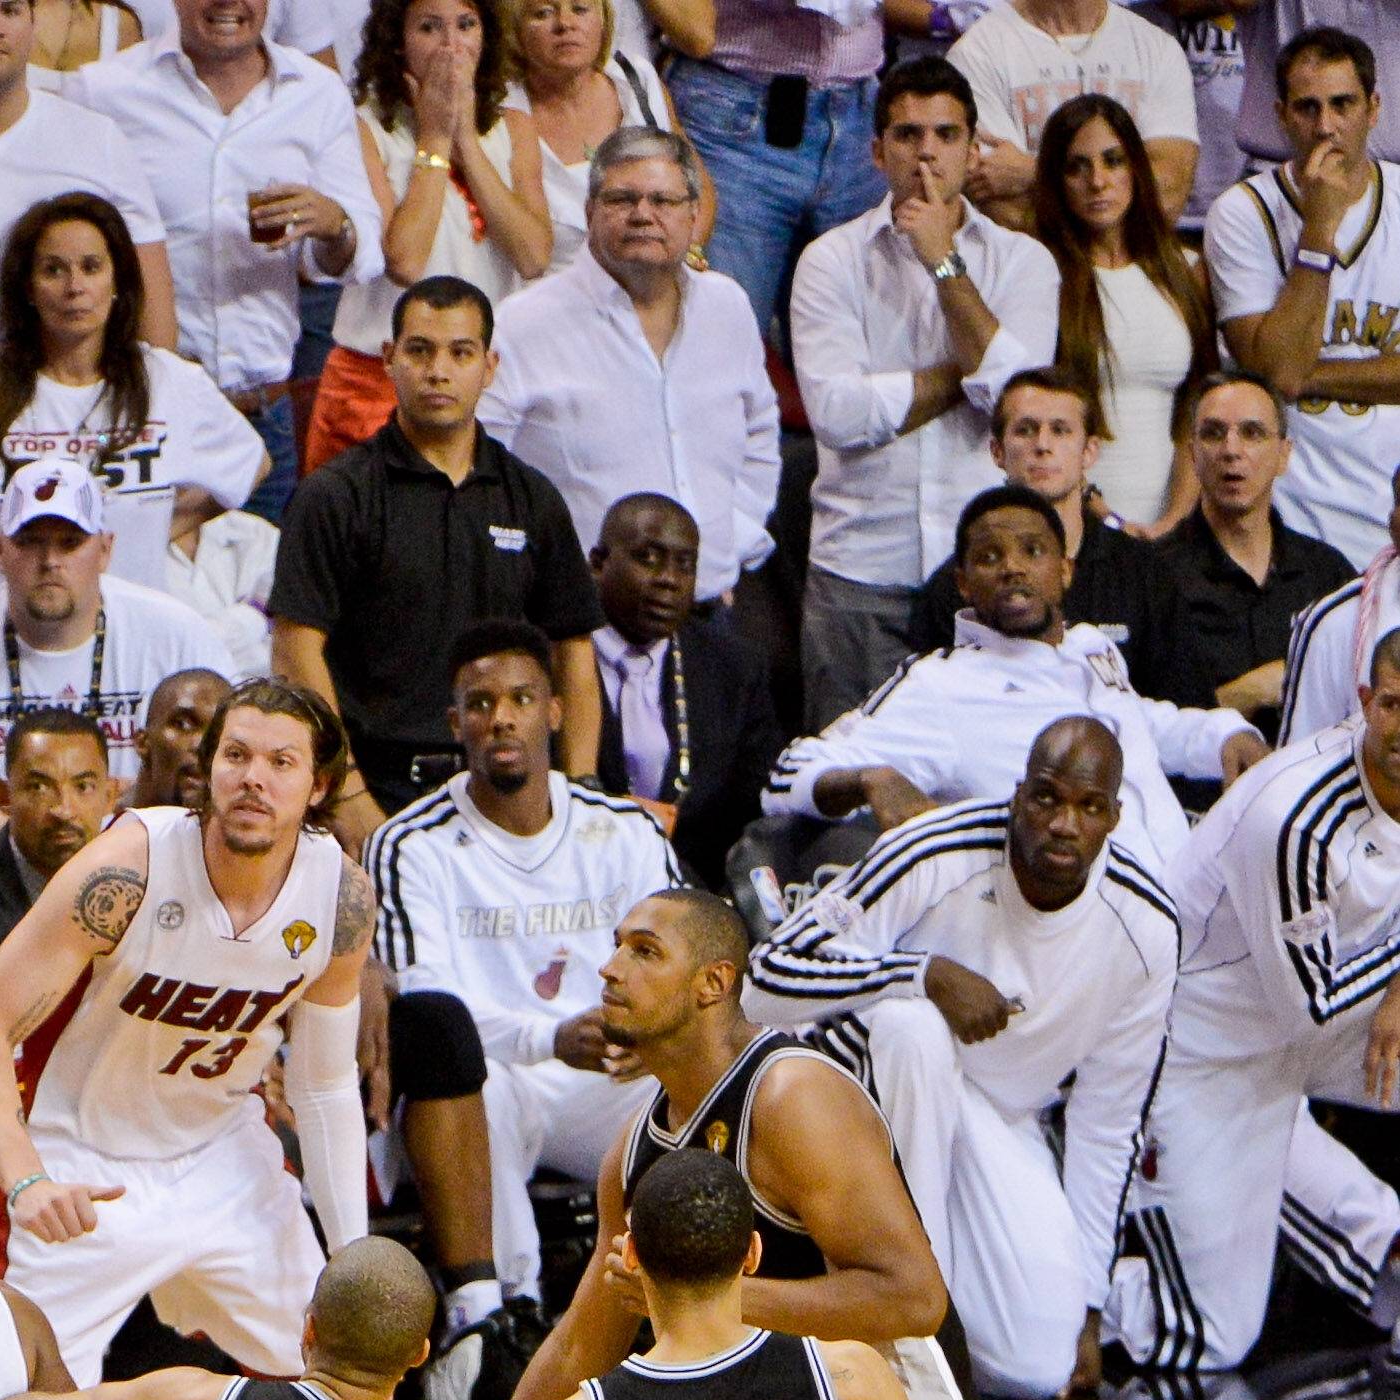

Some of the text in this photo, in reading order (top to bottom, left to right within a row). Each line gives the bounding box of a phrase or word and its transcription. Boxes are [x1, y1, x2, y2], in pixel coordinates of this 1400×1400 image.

[456, 905, 517, 938] THE
[118, 972, 305, 1034] HEAT
[158, 1036, 249, 1079] 13
